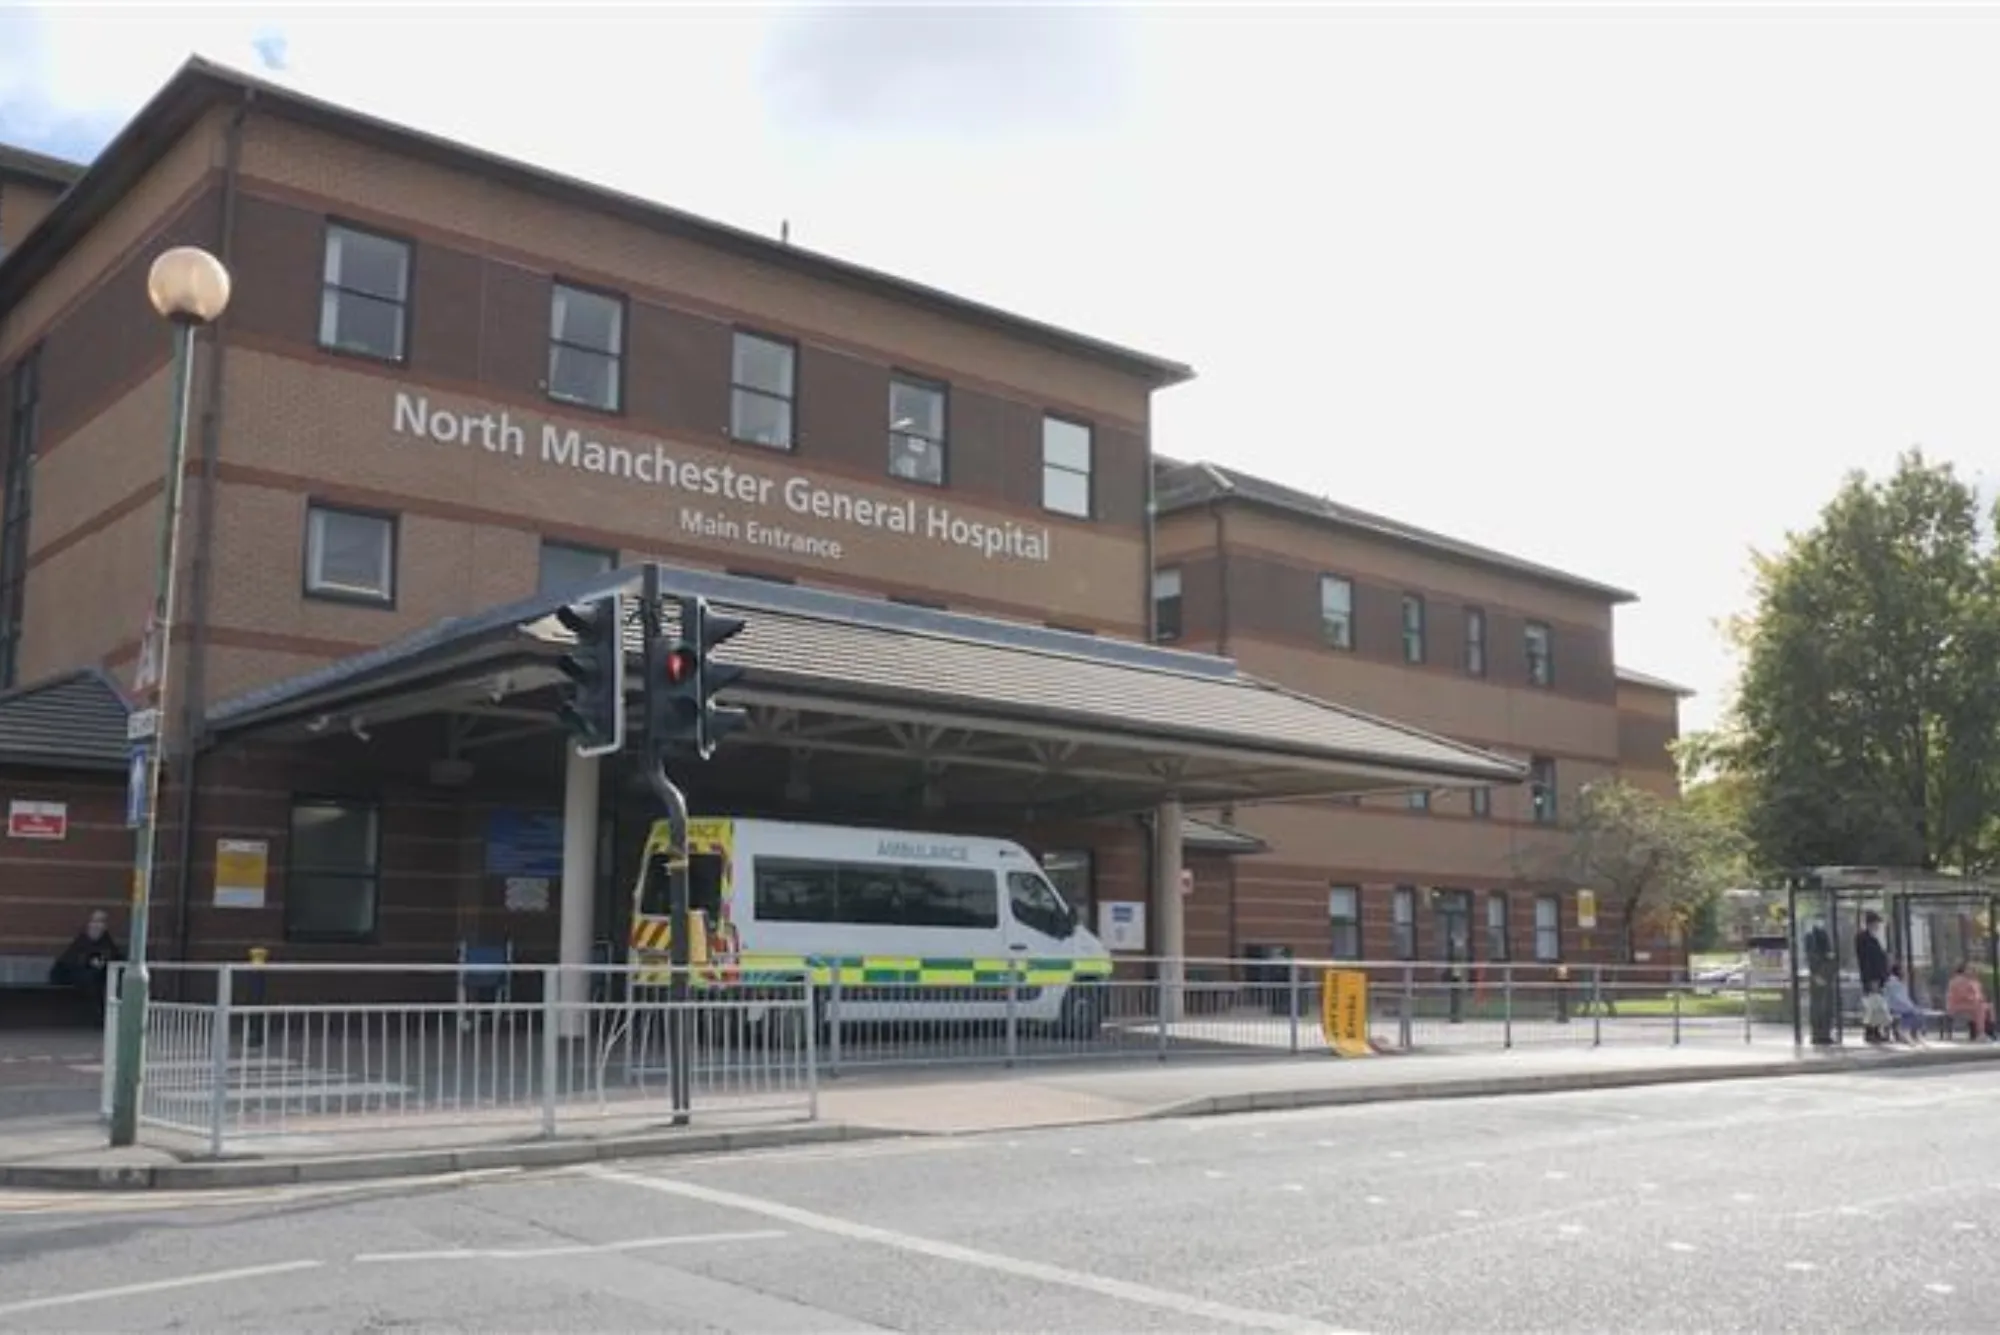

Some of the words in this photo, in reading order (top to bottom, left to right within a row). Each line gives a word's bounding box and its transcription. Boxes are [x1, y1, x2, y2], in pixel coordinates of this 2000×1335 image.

[393, 392, 525, 456] North
[541, 423, 774, 505] Manchester
[784, 476, 916, 534] General
[926, 505, 1050, 562] Hospital
[679, 507, 740, 540] Main
[746, 519, 844, 559] Entrance
